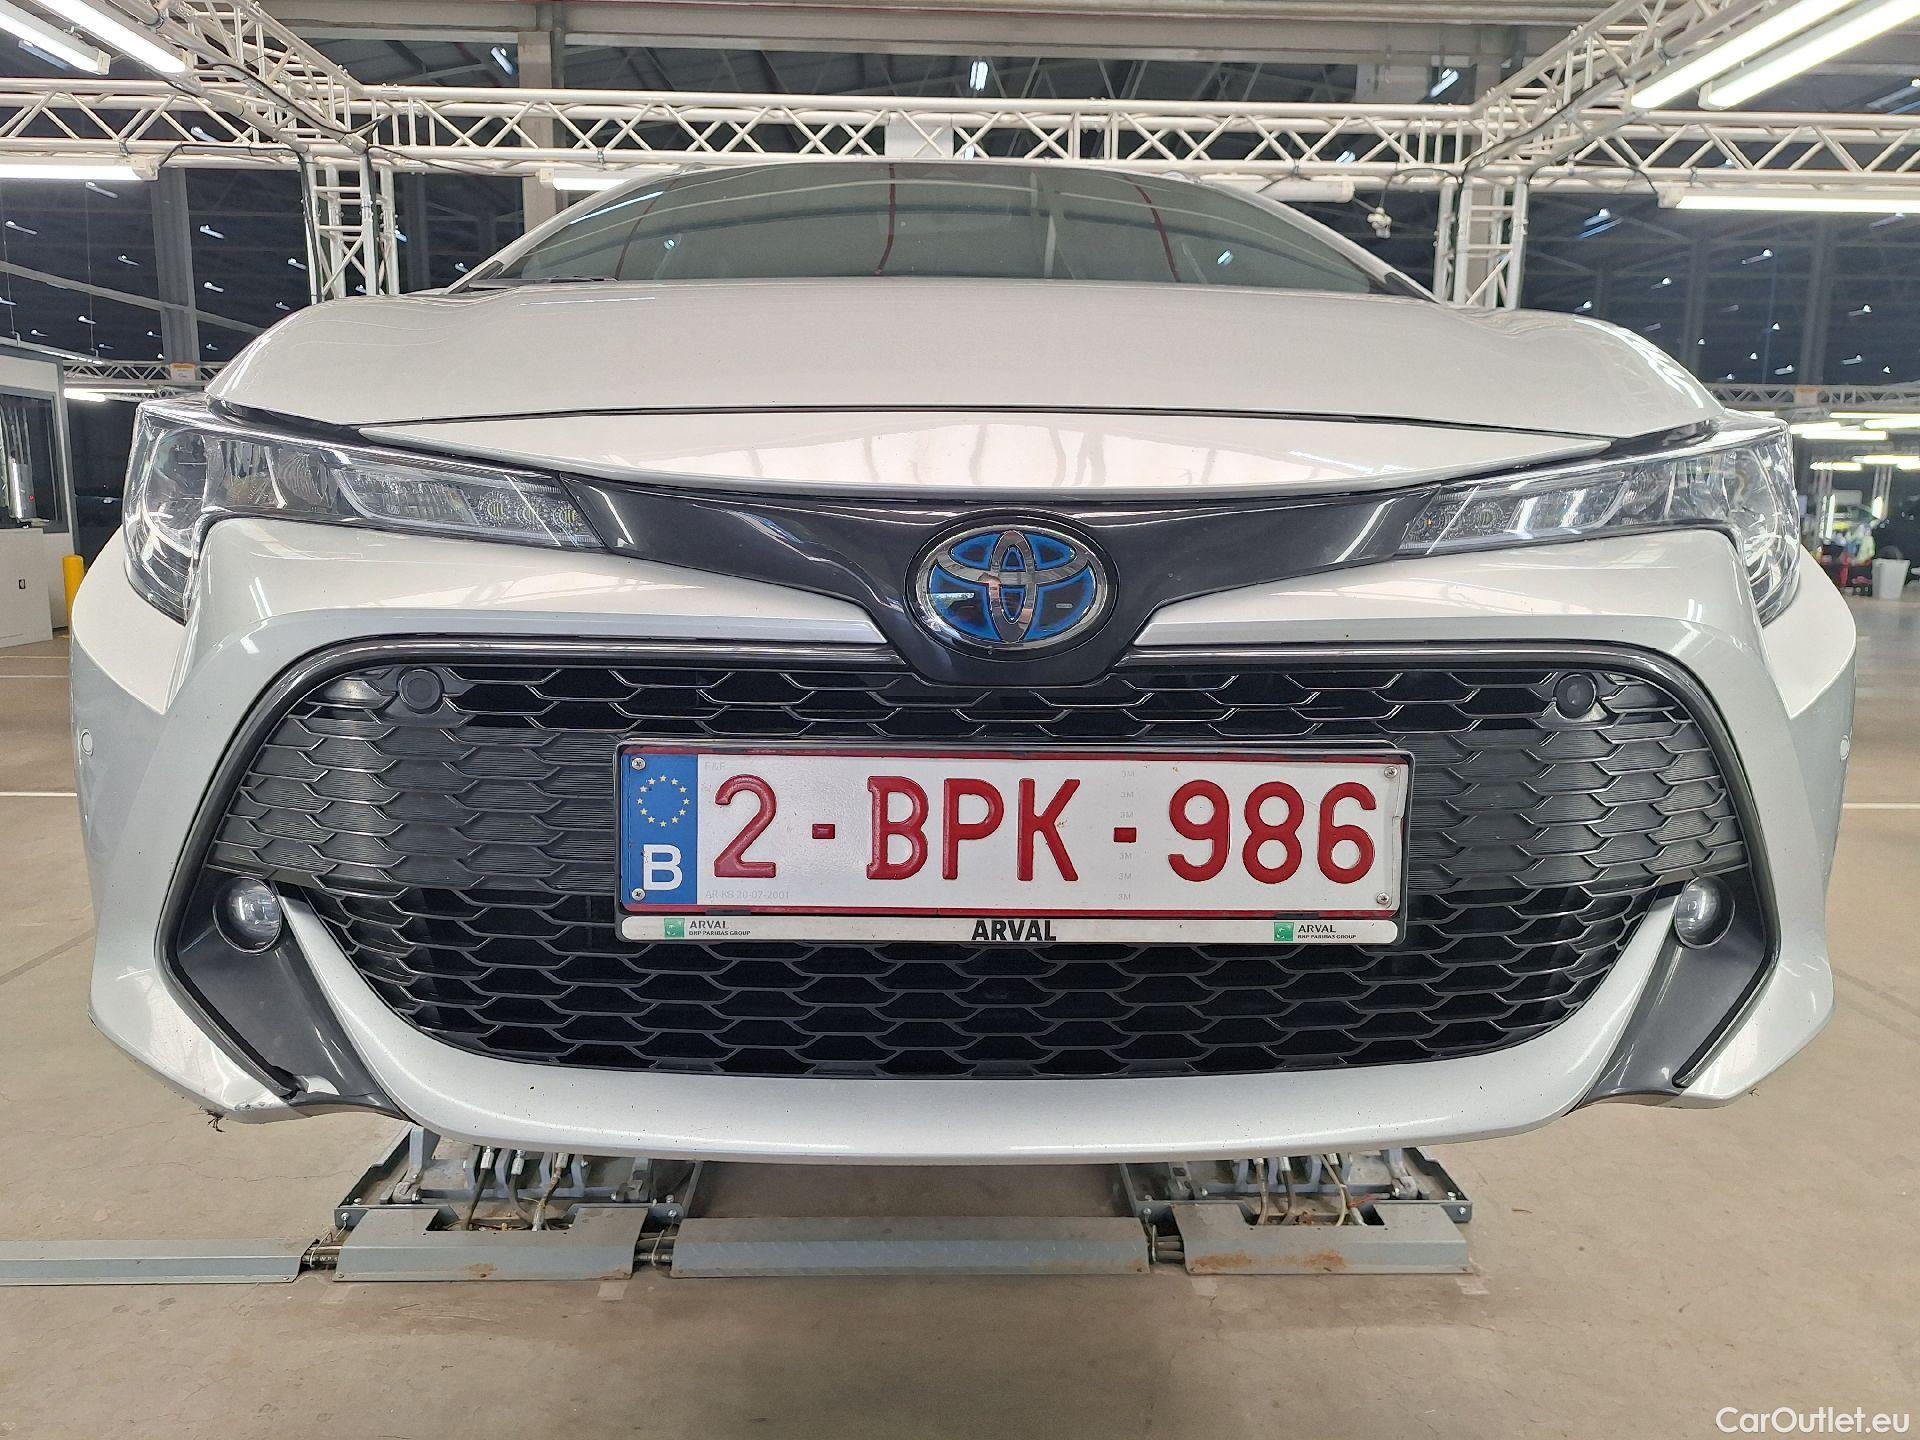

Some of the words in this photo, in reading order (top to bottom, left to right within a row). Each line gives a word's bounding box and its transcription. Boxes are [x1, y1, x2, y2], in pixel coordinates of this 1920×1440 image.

[643, 844, 683, 891] B
[689, 920, 729, 929] ARVAL
[971, 919, 1057, 941] ARVAL
[1298, 924, 1337, 933] ARVAL
